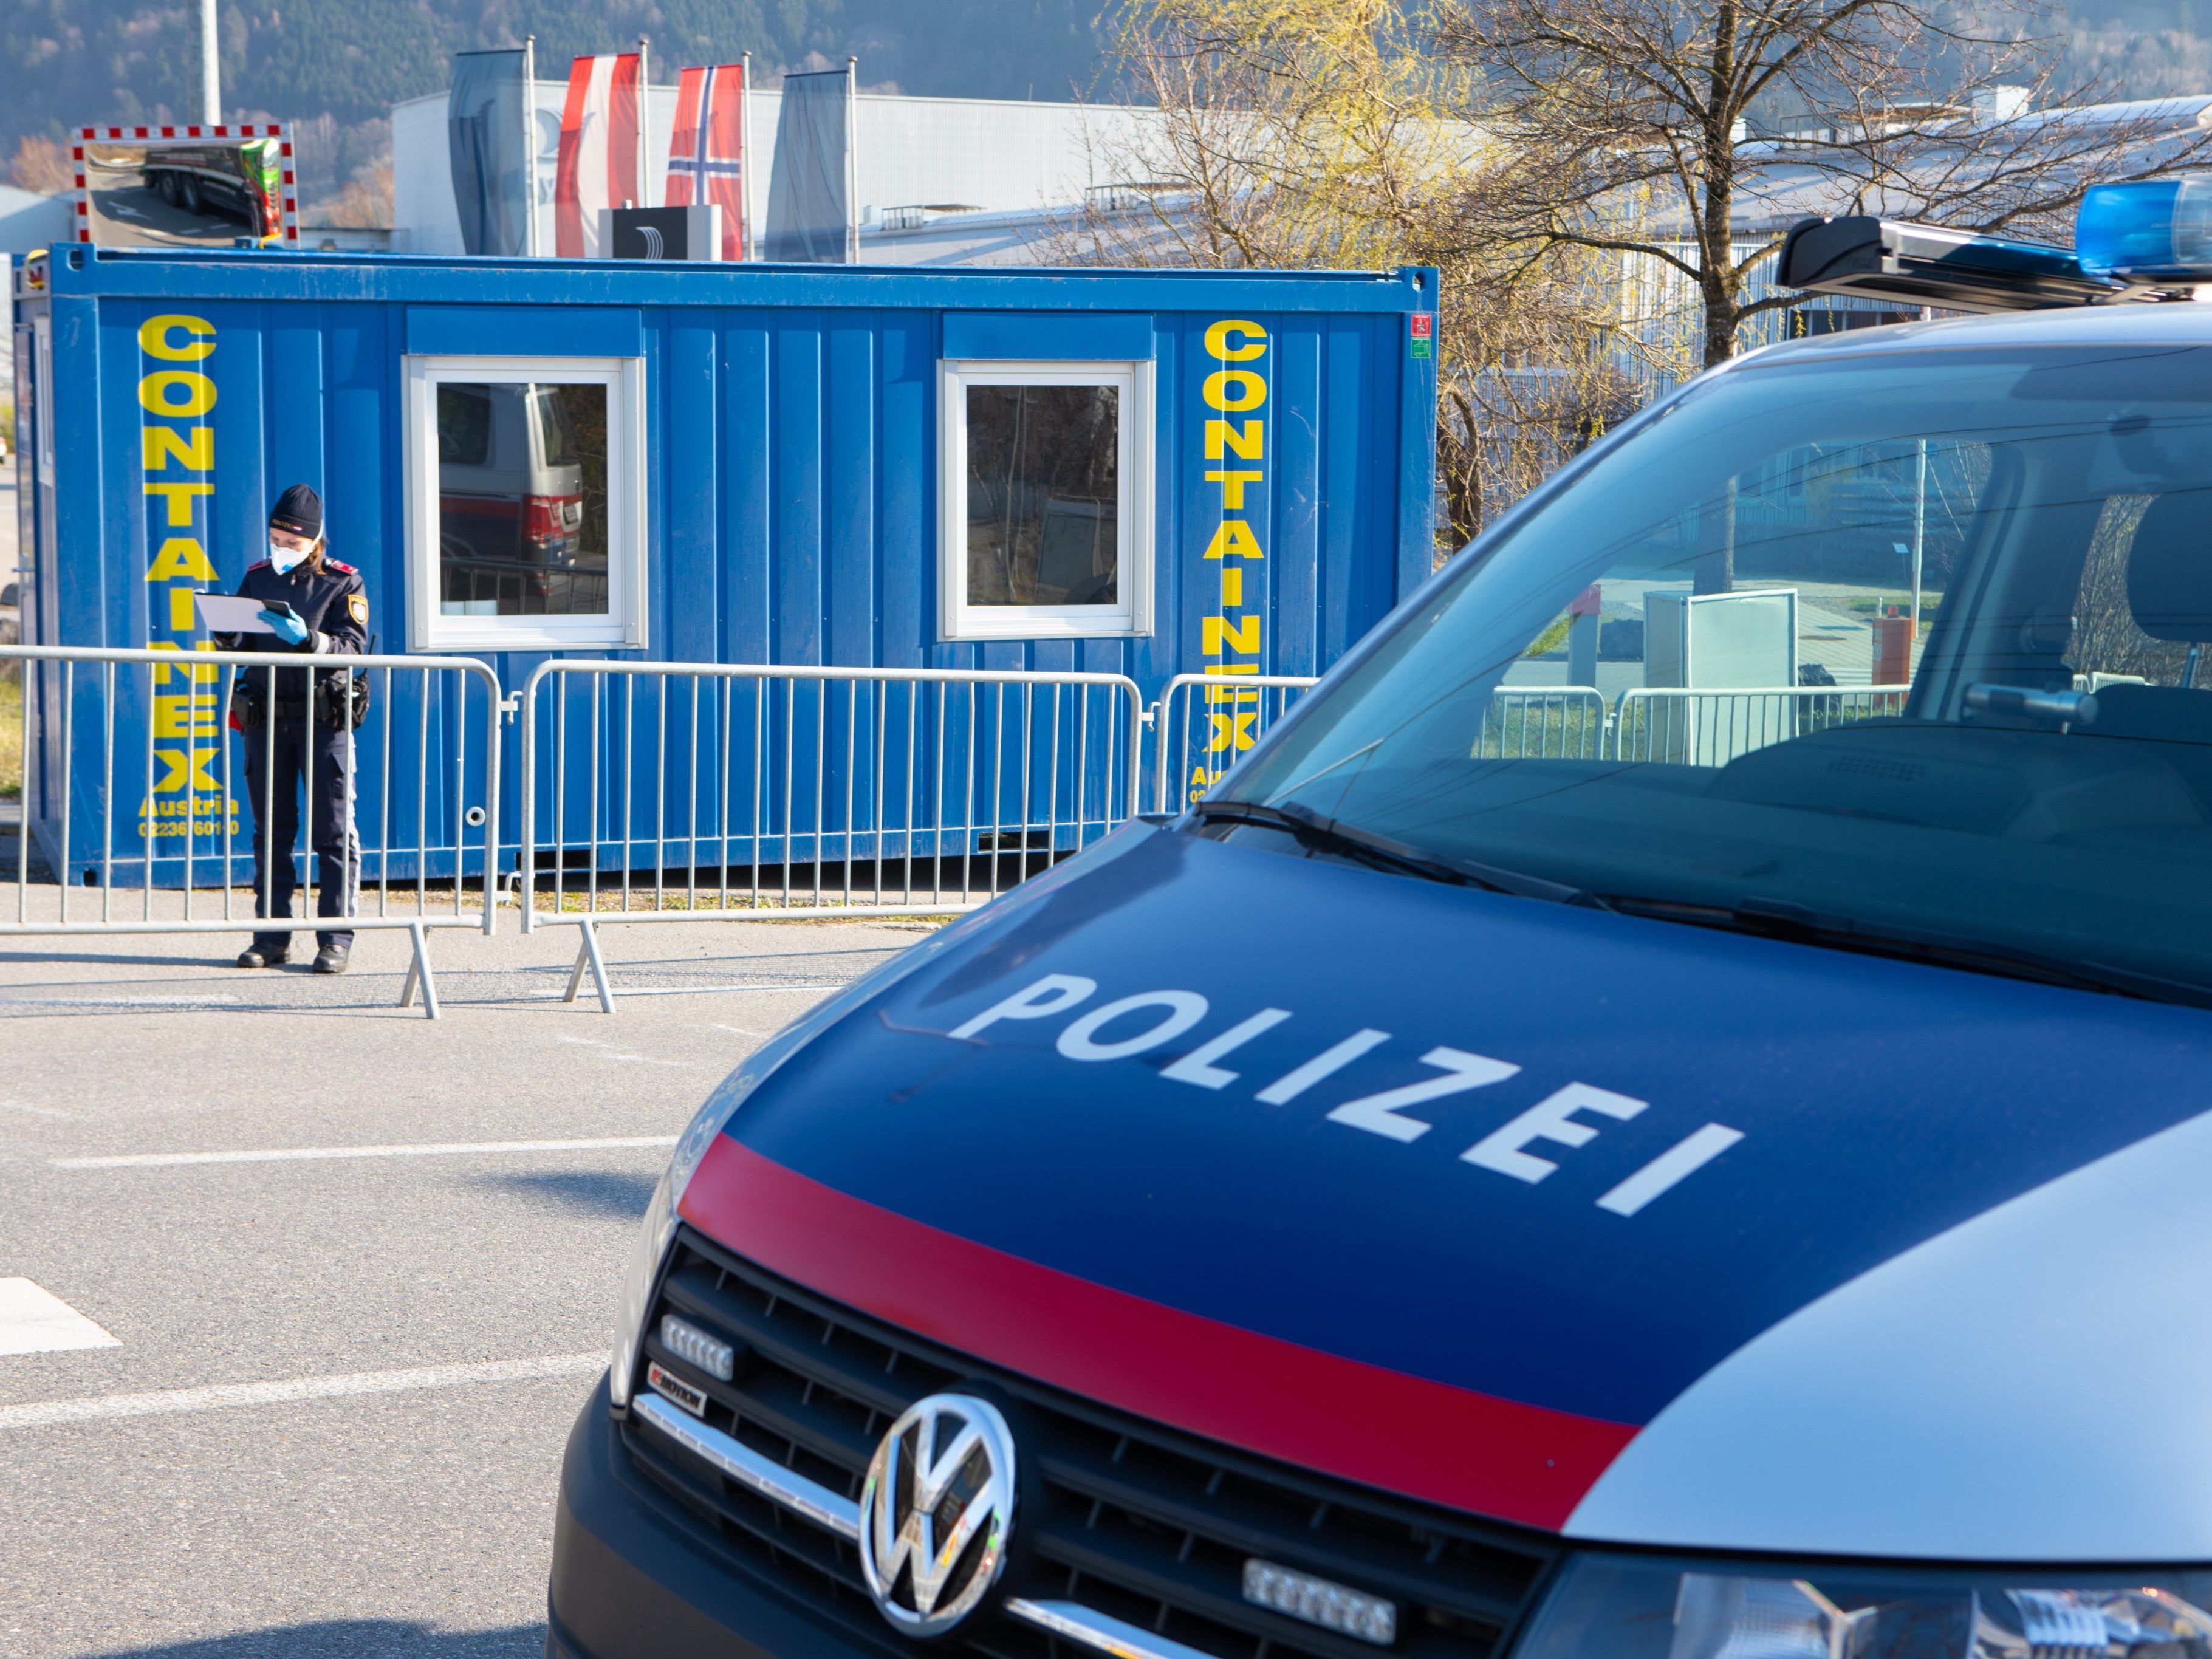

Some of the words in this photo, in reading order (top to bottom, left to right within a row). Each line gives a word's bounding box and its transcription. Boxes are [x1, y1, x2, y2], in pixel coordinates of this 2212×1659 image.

[137, 314, 224, 792] CONTAINEX
[1202, 320, 1267, 752] CONTAINEX
[138, 795, 239, 817] Austria
[138, 820, 239, 838] 022366010
[947, 973, 1744, 1216] POLIZEI
